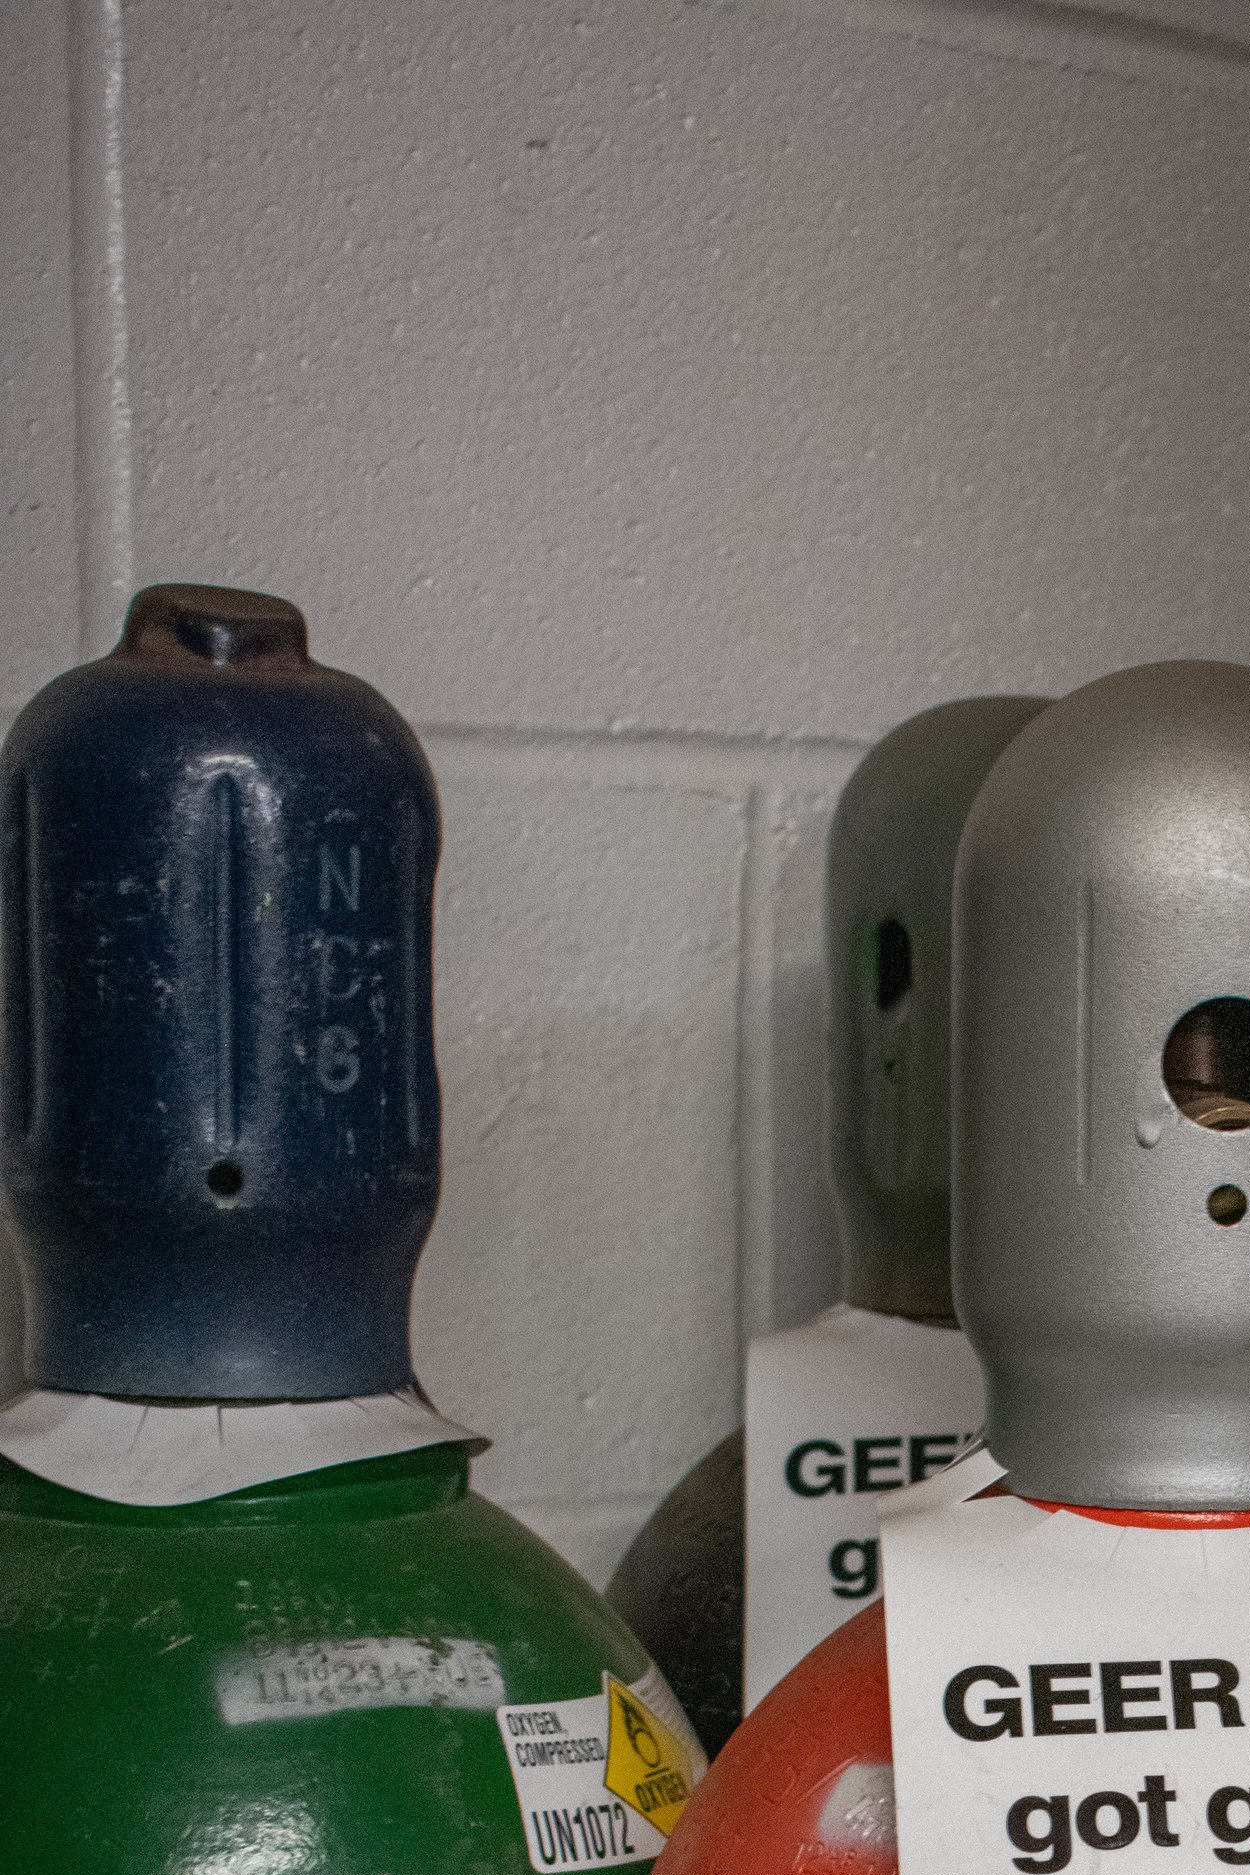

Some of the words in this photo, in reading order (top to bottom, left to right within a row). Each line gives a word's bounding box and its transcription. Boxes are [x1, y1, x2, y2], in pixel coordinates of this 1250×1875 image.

[784, 1432, 973, 1498] GEE
[505, 1710, 569, 1737] OXYGEN,
[943, 1657, 1245, 1742] GEER
[515, 1737, 605, 1767] COMPRESSED
[531, 1802, 635, 1866] UN1072
[1006, 1775, 1180, 1875] got
